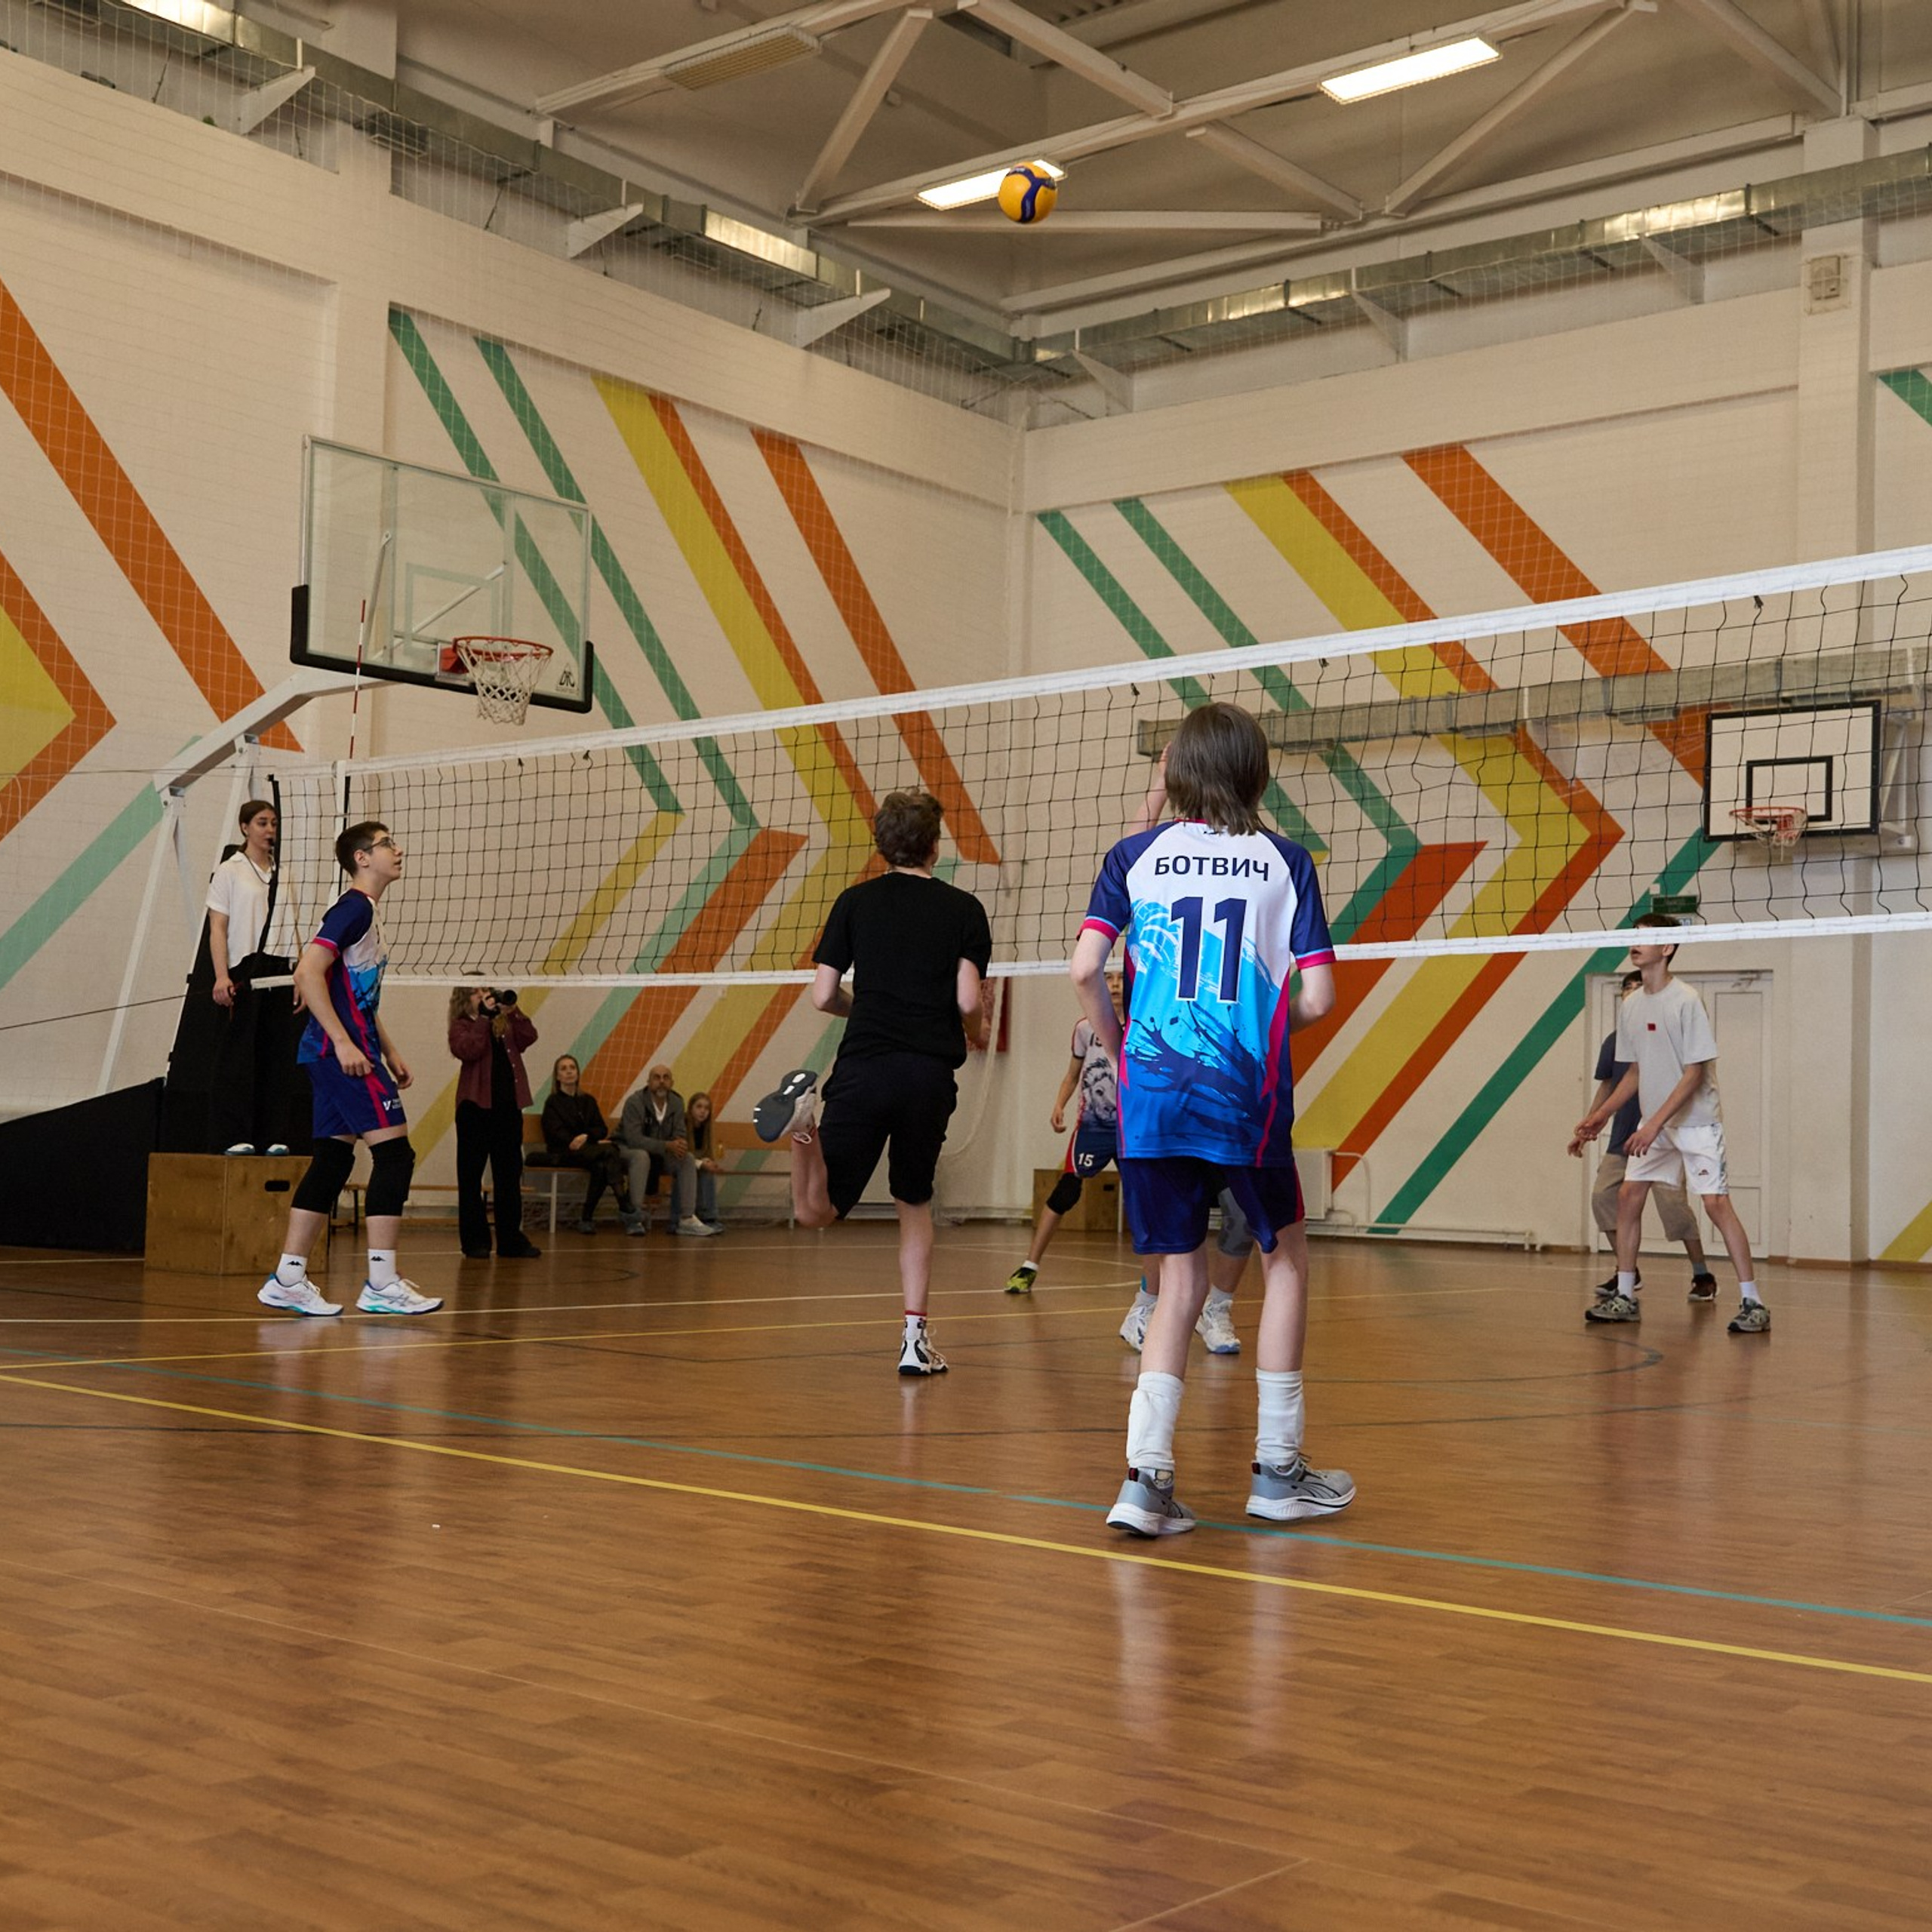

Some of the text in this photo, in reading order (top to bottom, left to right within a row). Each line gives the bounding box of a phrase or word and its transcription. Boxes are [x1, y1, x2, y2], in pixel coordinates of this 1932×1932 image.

[1155, 855, 1269, 881] БОТВИЧ
[1171, 896, 1247, 1003] 11
[1078, 1152, 1094, 1167] 15
